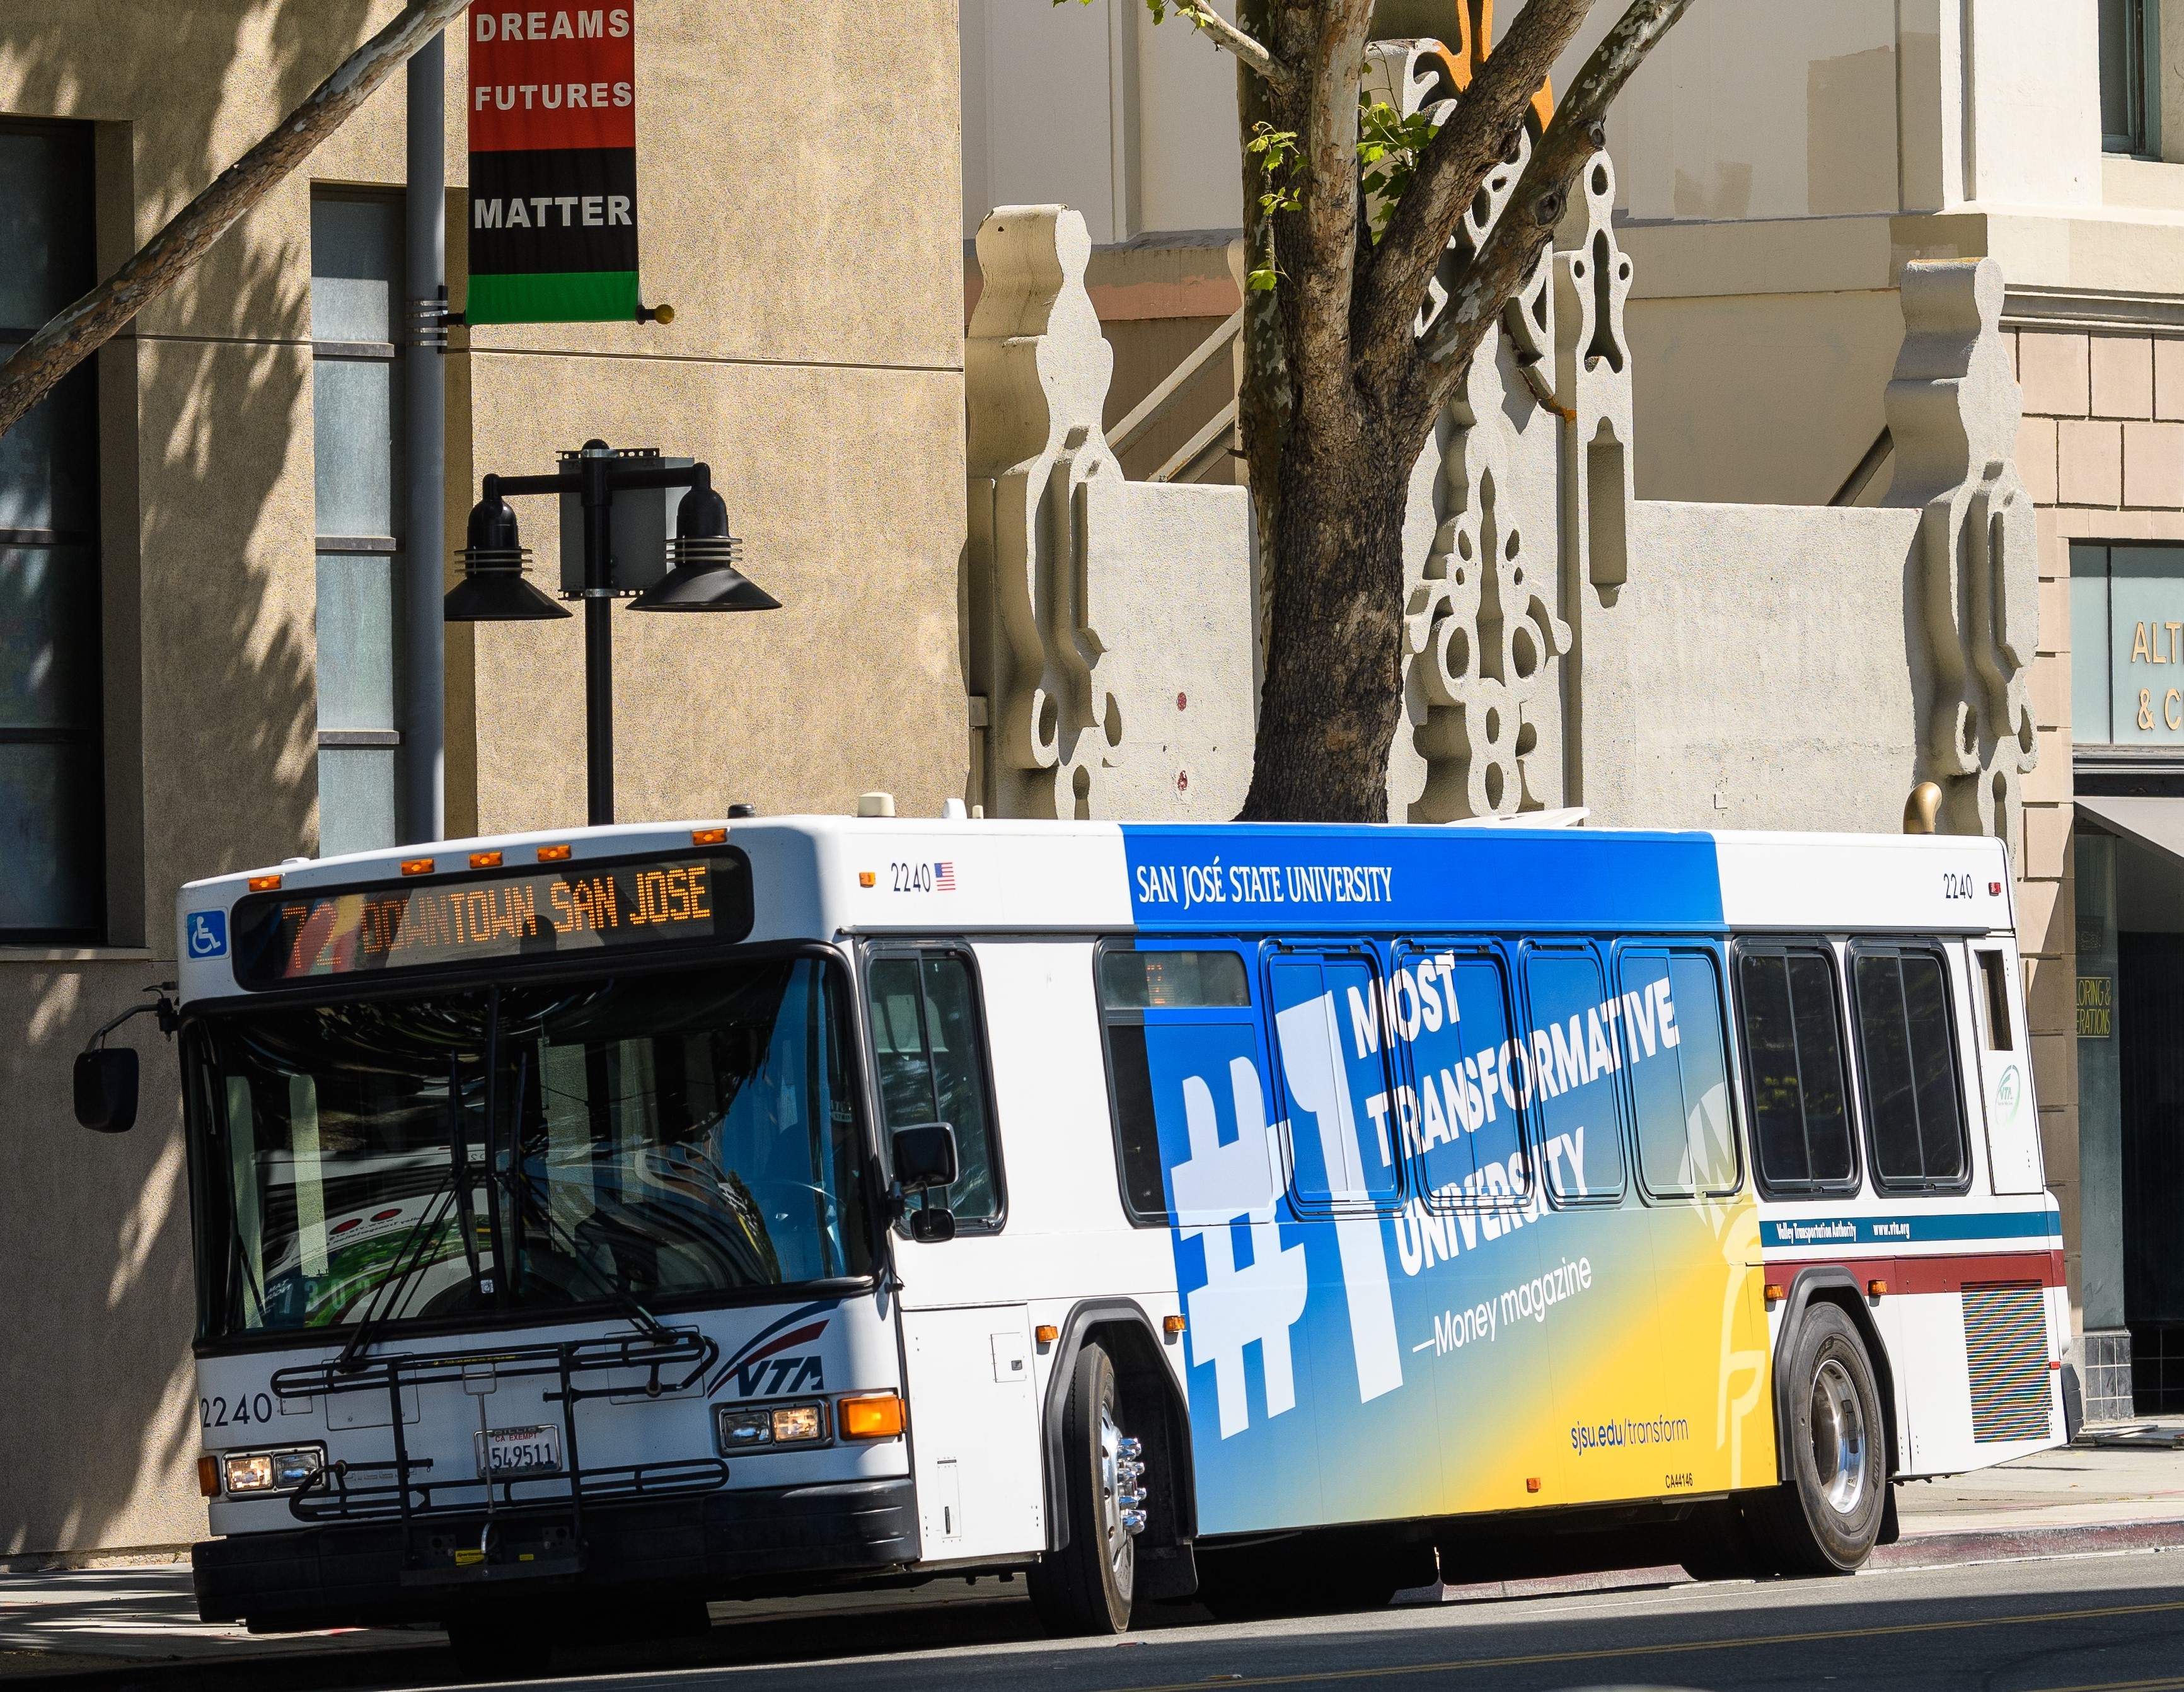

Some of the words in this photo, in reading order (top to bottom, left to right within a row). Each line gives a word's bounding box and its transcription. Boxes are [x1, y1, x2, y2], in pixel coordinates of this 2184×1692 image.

[476, 9, 630, 42] DREAMS
[475, 82, 632, 111] FUTURES
[475, 195, 633, 229] MATTER
[2132, 622, 2184, 664] ALT
[2137, 688, 2155, 731] &
[891, 862, 932, 893] 2240
[1137, 865, 1177, 903] SAN
[1182, 855, 1226, 910] JOSÉ
[1229, 866, 1284, 903] STATE
[1286, 866, 1392, 903] UNIVERSITY
[1943, 873, 1973, 899] 2240
[550, 876, 617, 934] SAN
[629, 866, 712, 925] JOSE
[1347, 951, 1460, 1059] MOST
[2105, 980, 2111, 1005] &
[1366, 976, 1681, 1168] TRANSFORMATIVE
[1170, 990, 1404, 1440] #1
[1392, 1126, 1588, 1276] UNIVERSITY
[1776, 1222, 1793, 1244] Valley
[1793, 1222, 1832, 1243] Transportation
[1832, 1220, 1856, 1242] Authority
[1873, 1222, 1910, 1239] www.vta.org
[1502, 1256, 1592, 1326] magazine
[736, 1356, 824, 1396] VTA
[201, 1392, 273, 1428] 2240
[495, 1435, 506, 1443] CA
[509, 1432, 537, 1442] EXEMPT
[1571, 1415, 1689, 1456] sjsu.edu/transform
[1665, 1473, 1693, 1489] CA44146
